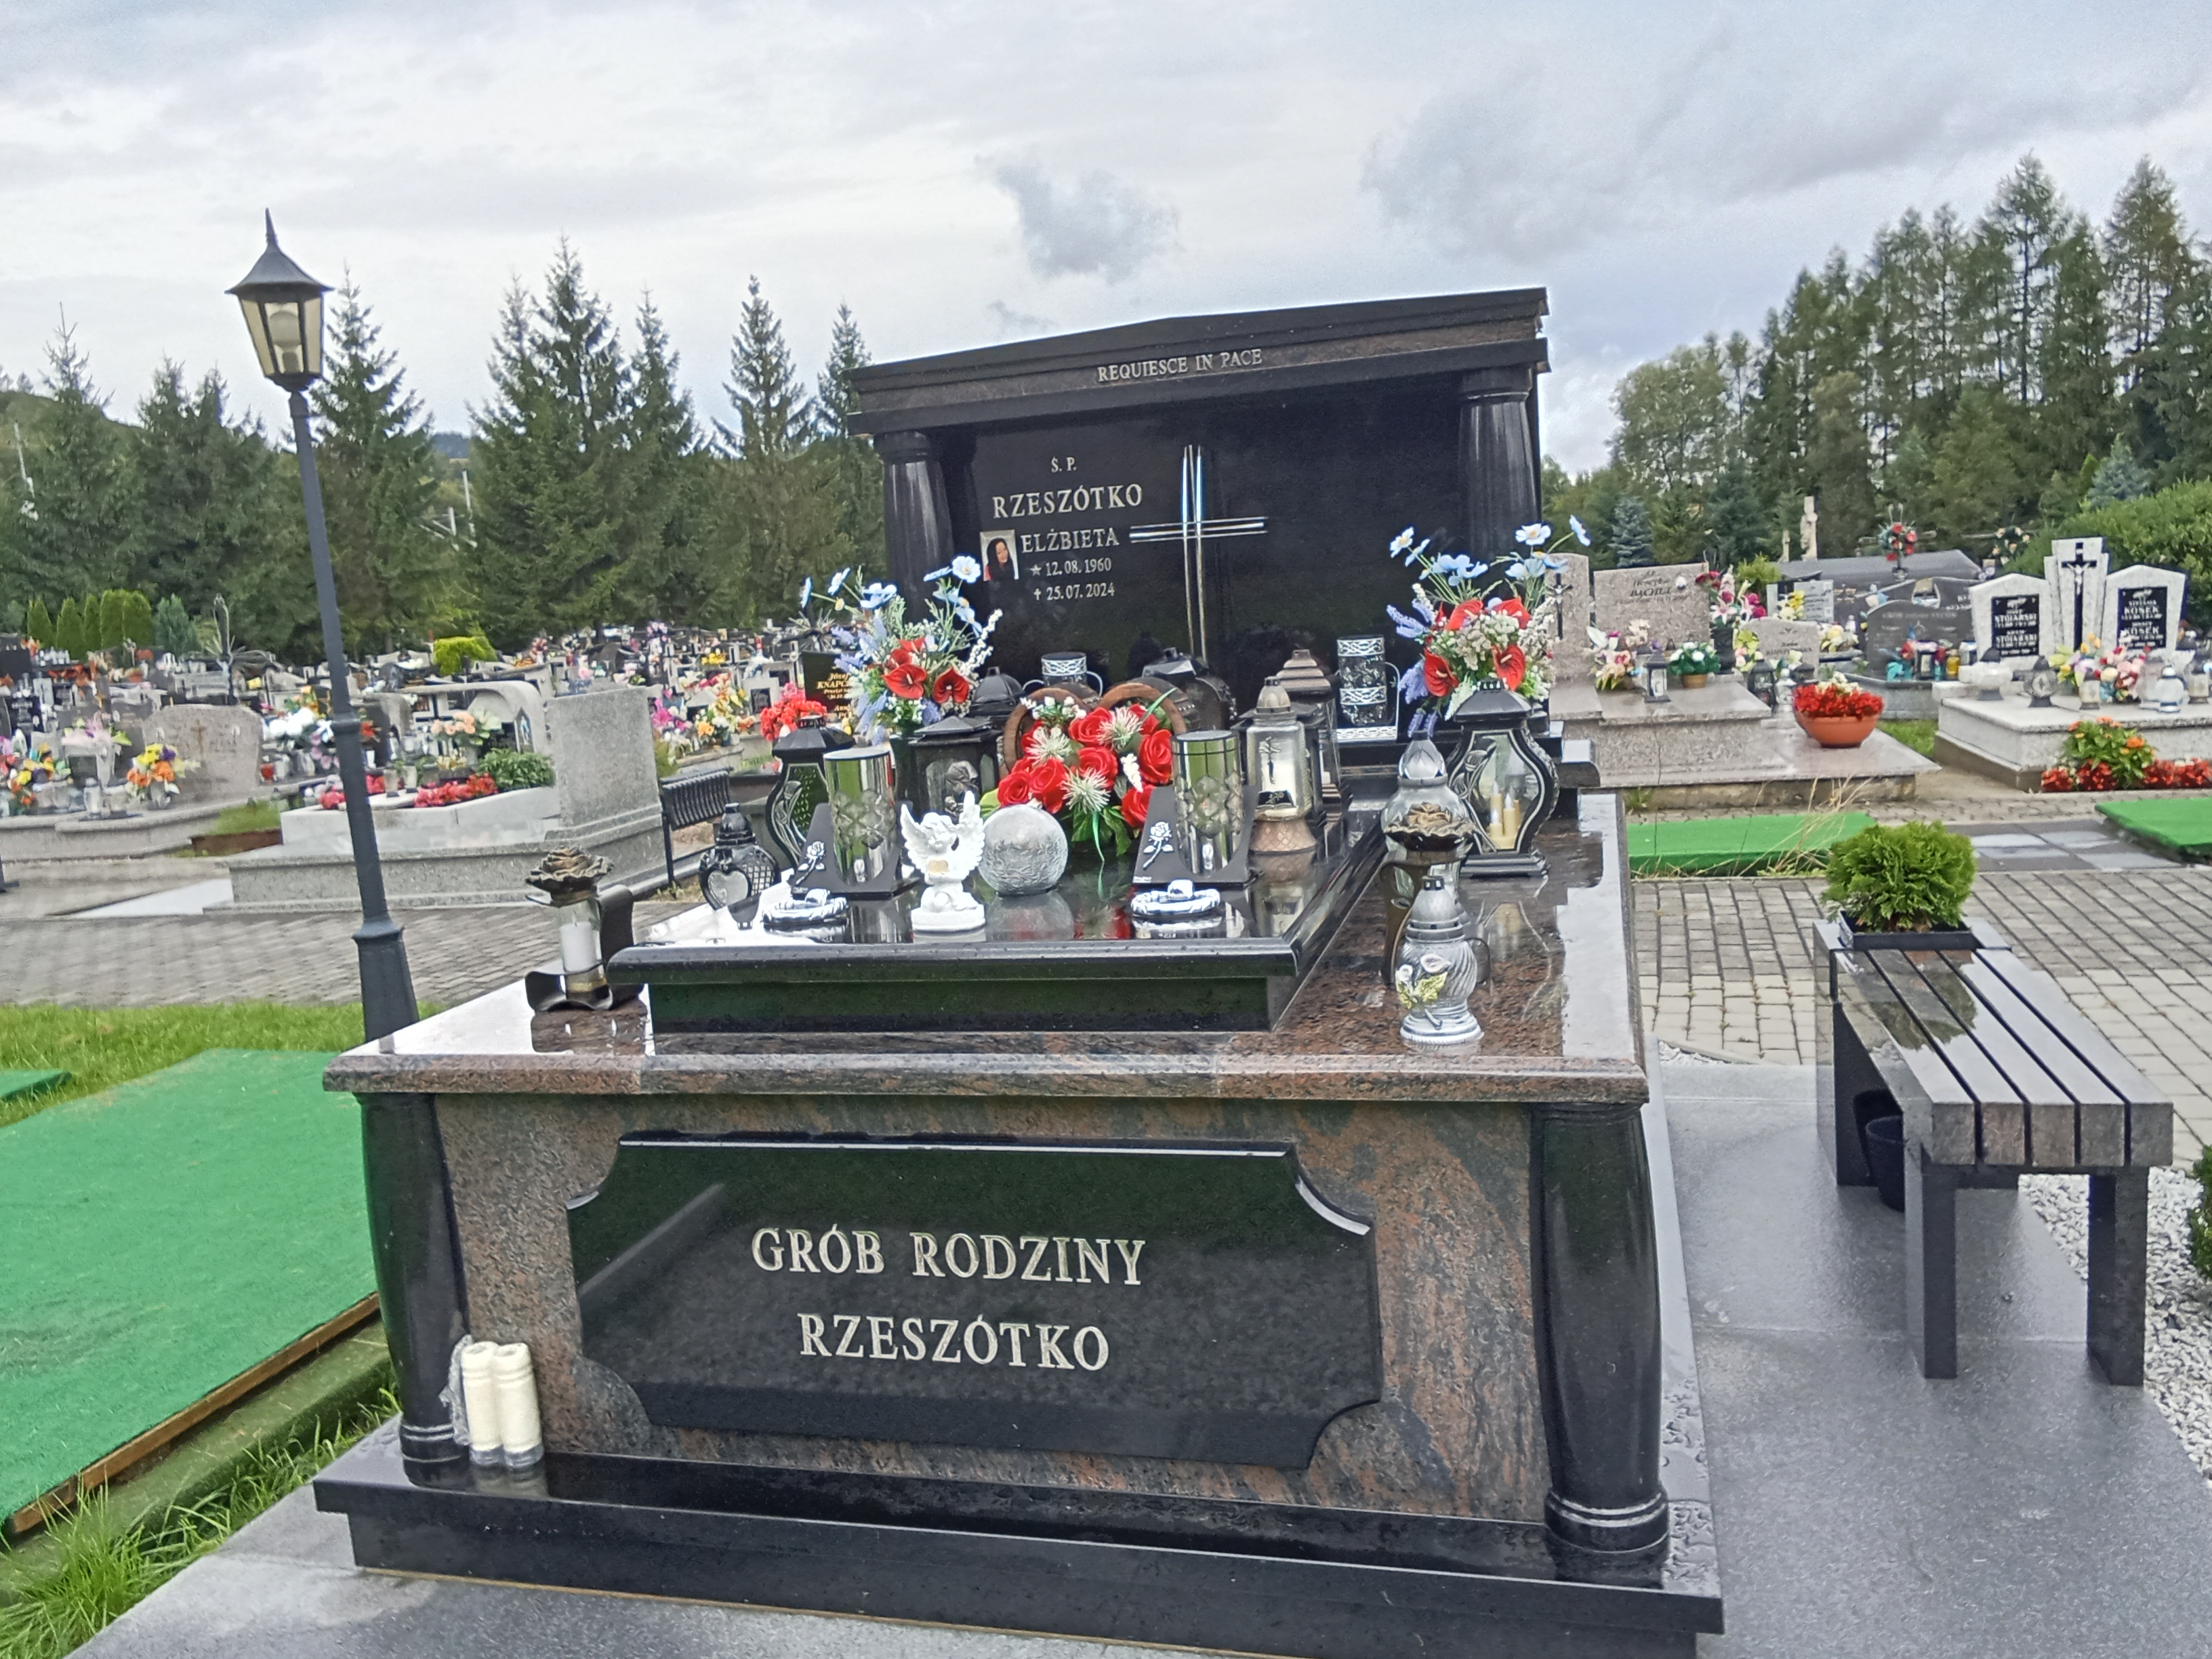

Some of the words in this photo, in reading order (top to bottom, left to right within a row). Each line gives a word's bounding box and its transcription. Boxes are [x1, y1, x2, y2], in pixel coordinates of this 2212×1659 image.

[1097, 356, 1188, 383] REQUIESCE
[1195, 354, 1213, 371] IN
[1220, 348, 1263, 368] PACE
[992, 483, 1143, 519] RZESZÓTKO
[1020, 527, 1120, 554] ELŻBIETA
[751, 1223, 885, 1275] GRÓB
[909, 1231, 1147, 1286] RODZINY
[796, 1312, 1110, 1371] RZESZÓTKO
